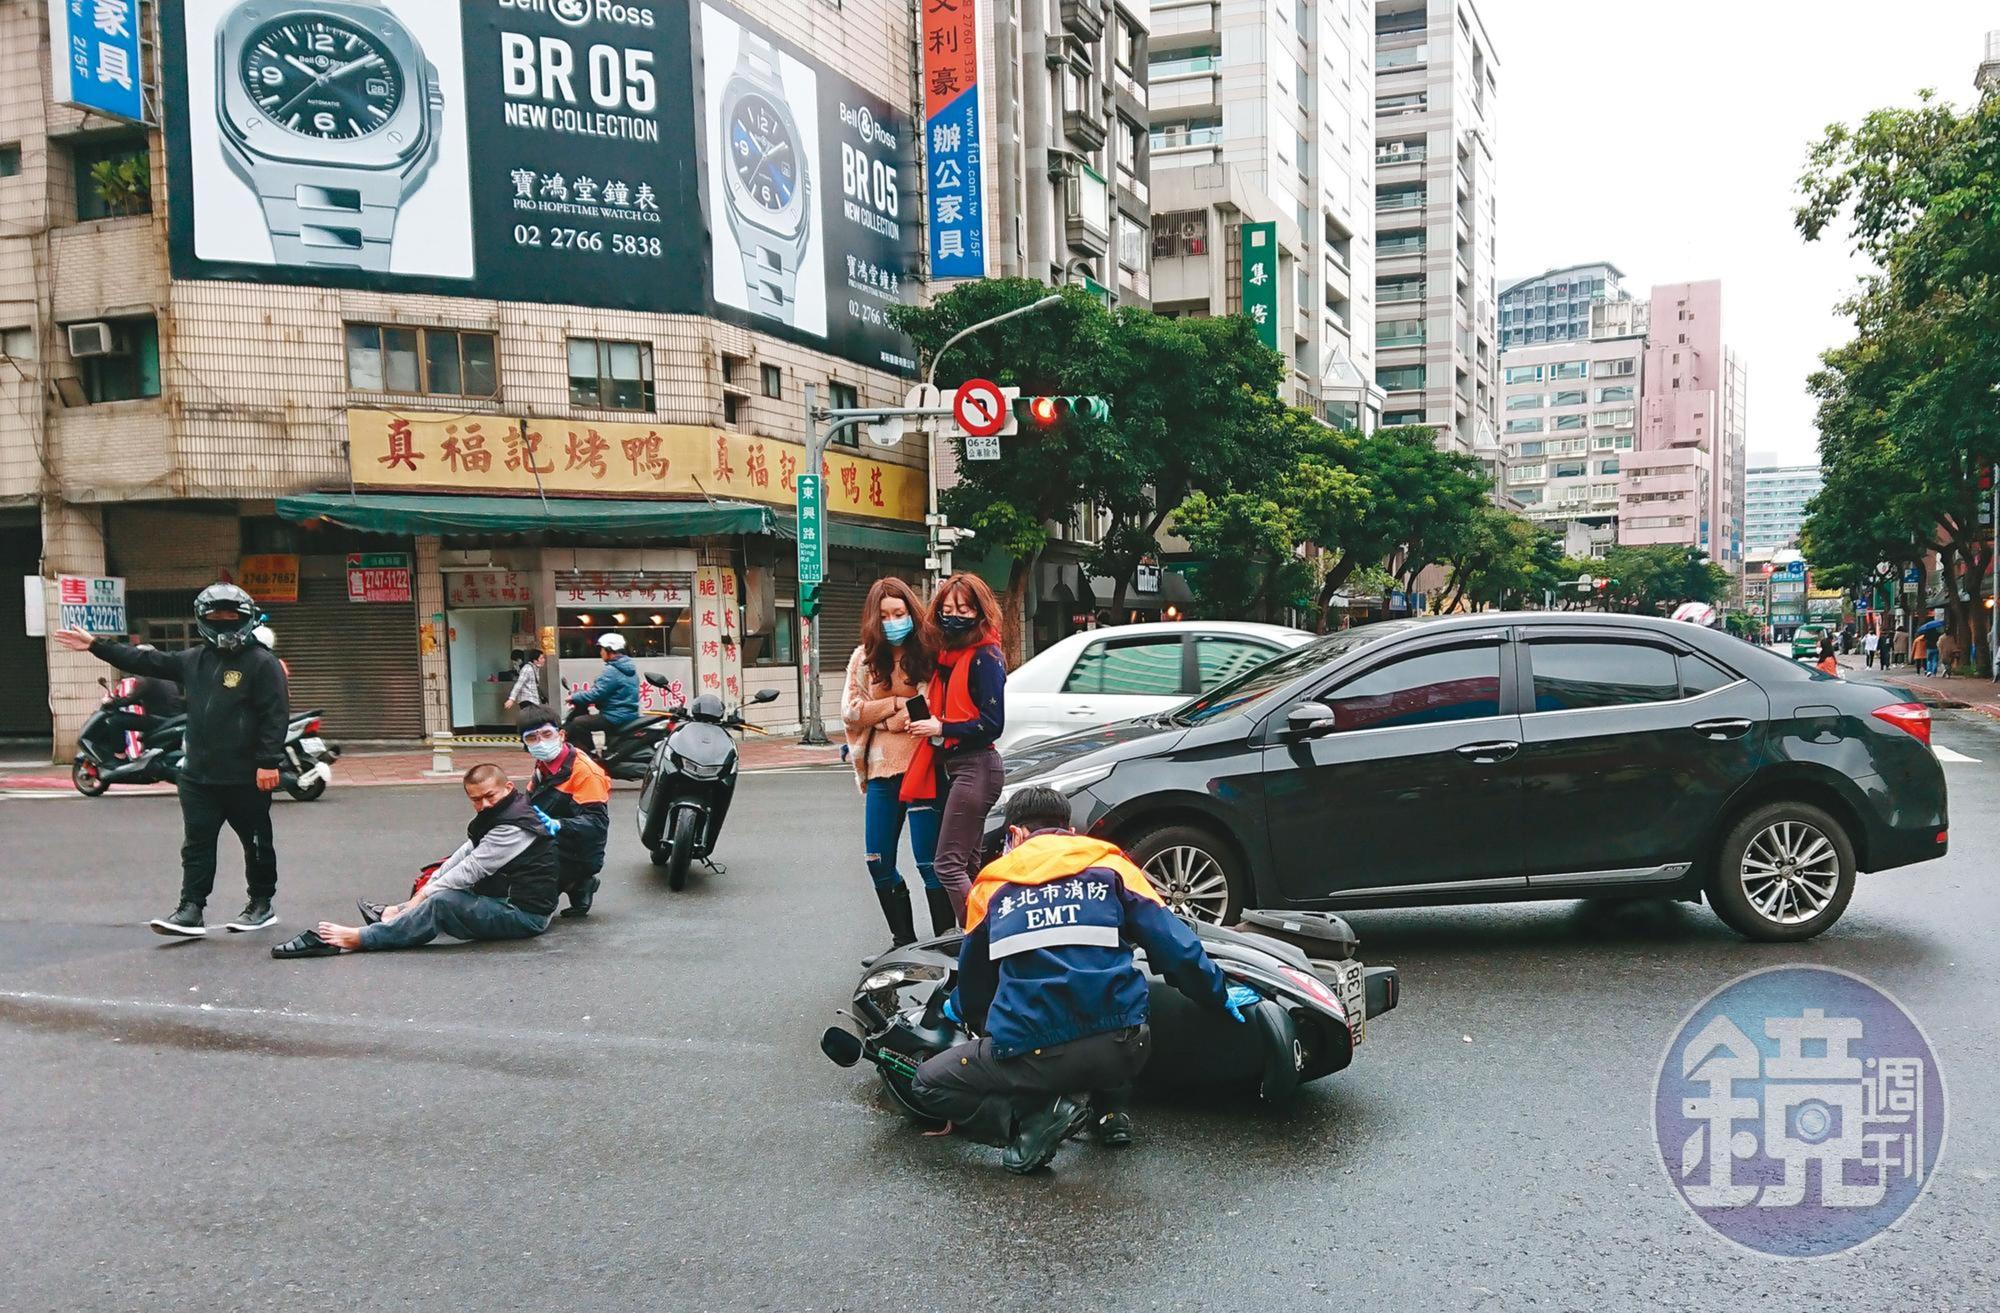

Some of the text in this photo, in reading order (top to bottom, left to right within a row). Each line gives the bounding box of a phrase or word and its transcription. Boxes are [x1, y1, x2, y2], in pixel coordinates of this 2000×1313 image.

[596, 0, 655, 26] Ross
[73, 35, 88, 78] 2/5F
[308, 32, 334, 51] 12
[501, 31, 656, 112] BR 05
[314, 113, 335, 130] 6
[505, 102, 659, 142] NEW COLLECTION
[840, 101, 857, 128] Bell
[874, 121, 896, 150] Ross
[511, 168, 660, 210] 寶鴻堂鐘表
[841, 141, 898, 217] BR 05
[933, 123, 965, 260] 辦公家具
[513, 199, 661, 222] PRO HOPETIME WATCH CO.
[844, 199, 899, 240] NEW COLLECTION
[514, 224, 662, 257] 02 2766 5838
[969, 229, 981, 257] 2/5F
[848, 299, 860, 318] 02
[862, 304, 881, 325] 2766
[377, 418, 670, 480] 真福記烤鴨
[967, 438, 998, 447] 06-24
[713, 436, 885, 507] 真福記鴨莊
[802, 486, 816, 540] 東興路
[365, 570, 408, 589] 2747-1122
[699, 579, 720, 690] 脆皮烤鴨
[997, 879, 1110, 919] 臺北市消防
[1025, 904, 1081, 929] EMT
